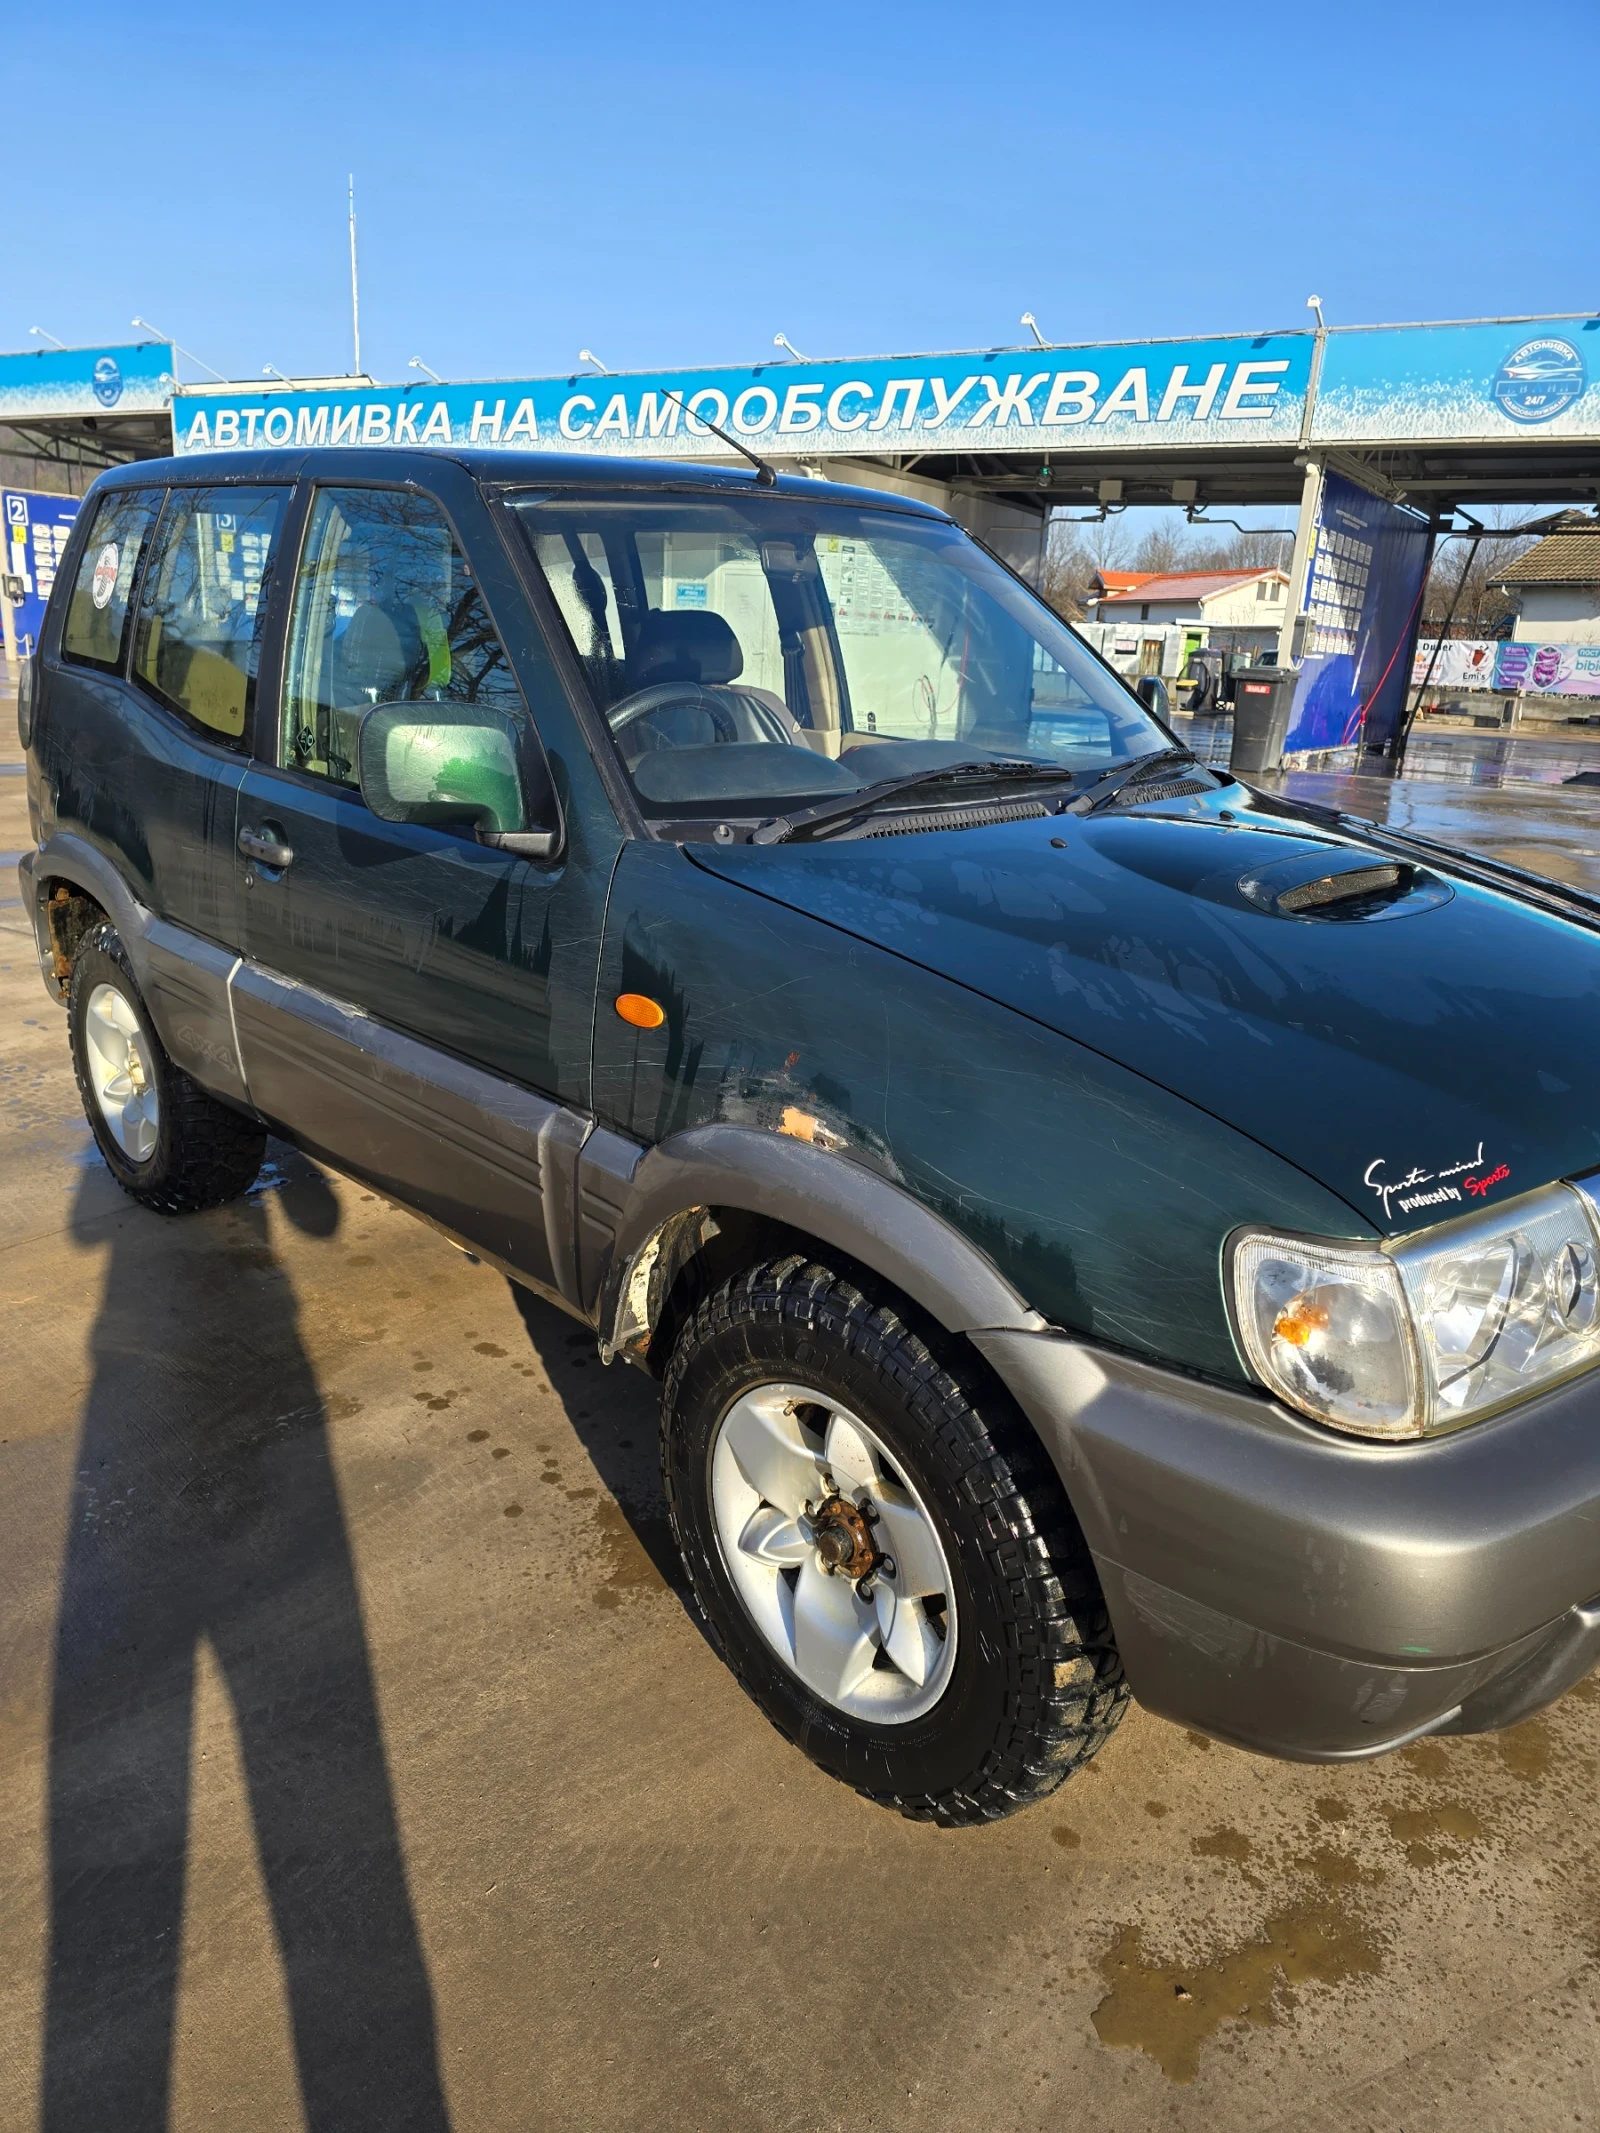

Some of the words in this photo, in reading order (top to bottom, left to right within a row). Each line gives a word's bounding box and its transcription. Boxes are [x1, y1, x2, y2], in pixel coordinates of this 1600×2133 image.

[1514, 341, 1574, 363] АВТОМИВКА
[185, 401, 453, 448] АВТОМИВКА
[469, 398, 540, 443] НА
[558, 360, 1291, 440] САМООБСЛУЖВАНЕ
[1524, 395, 1547, 406] 24/7
[11, 500, 24, 522] 2
[1398, 1188, 1449, 1214] produced
[1447, 1186, 1462, 1201] by
[1463, 1163, 1511, 1197] Sports
